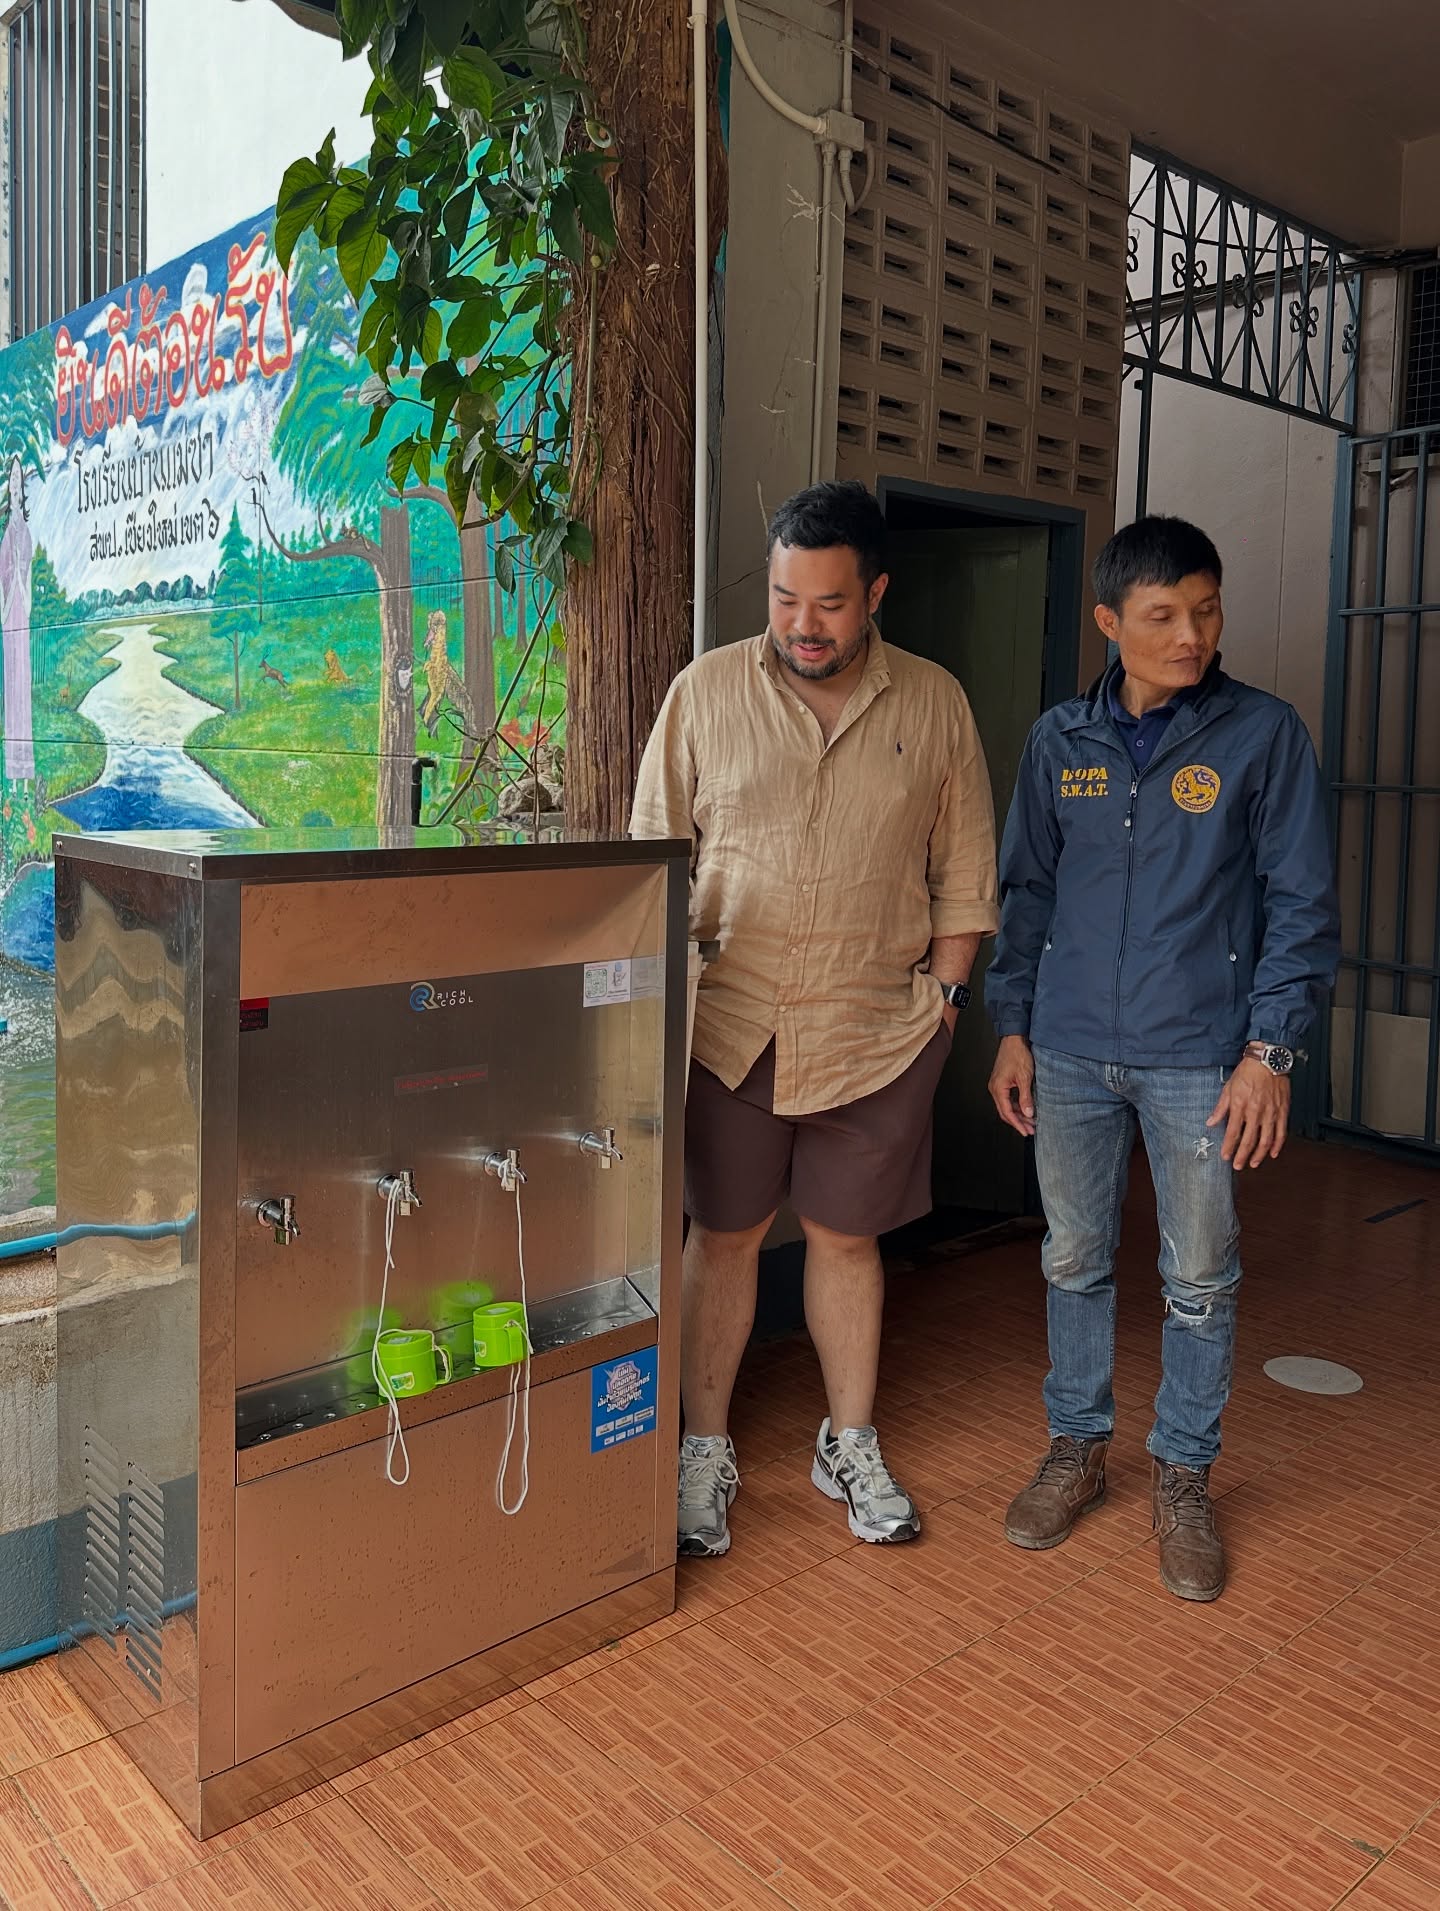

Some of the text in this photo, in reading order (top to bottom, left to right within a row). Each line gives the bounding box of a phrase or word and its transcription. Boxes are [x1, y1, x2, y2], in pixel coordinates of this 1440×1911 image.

[56, 231, 293, 447] ยินดีต้อนรับ
[1061, 767, 1109, 782] DOPA
[1061, 783, 1109, 798] S.W.A.T.
[437, 989, 466, 1000] RICH
[440, 996, 474, 1007] COOL
